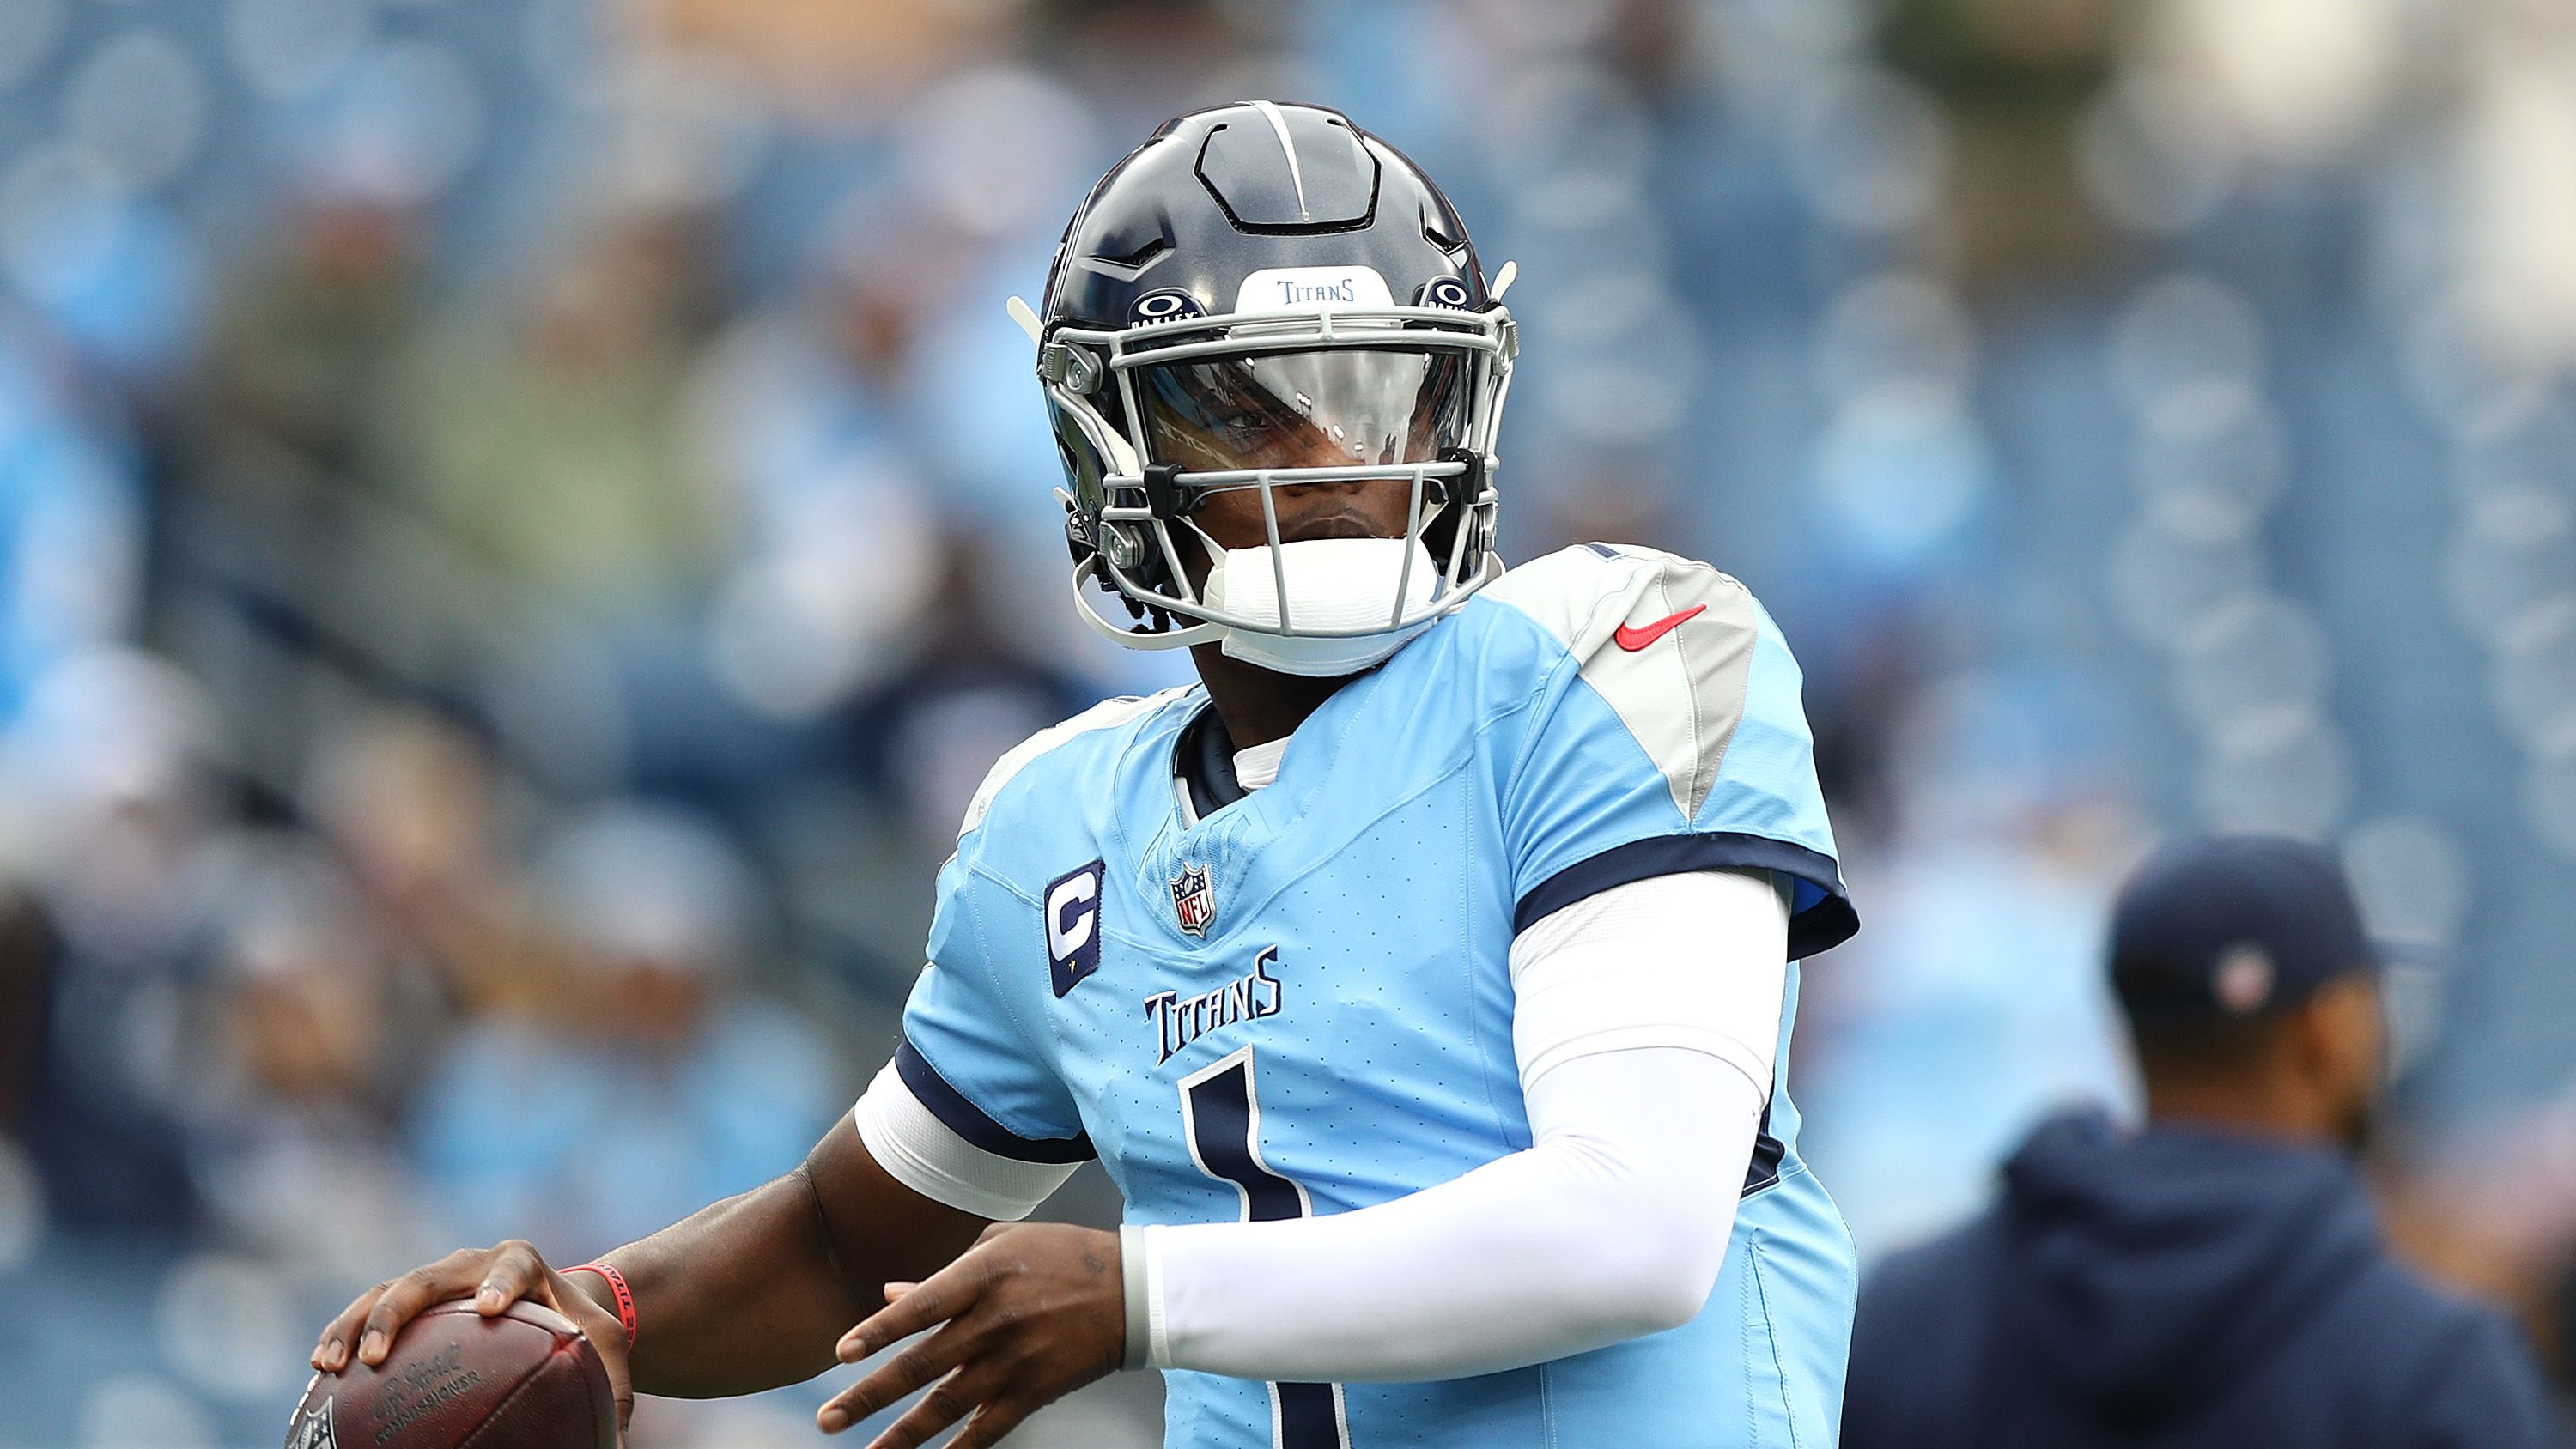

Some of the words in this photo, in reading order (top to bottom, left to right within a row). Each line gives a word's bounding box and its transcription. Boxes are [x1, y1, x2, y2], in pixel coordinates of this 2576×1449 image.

[1048, 870, 1096, 962] C
[1179, 894, 1208, 925] NFL
[1143, 943, 1282, 1067] TITANS
